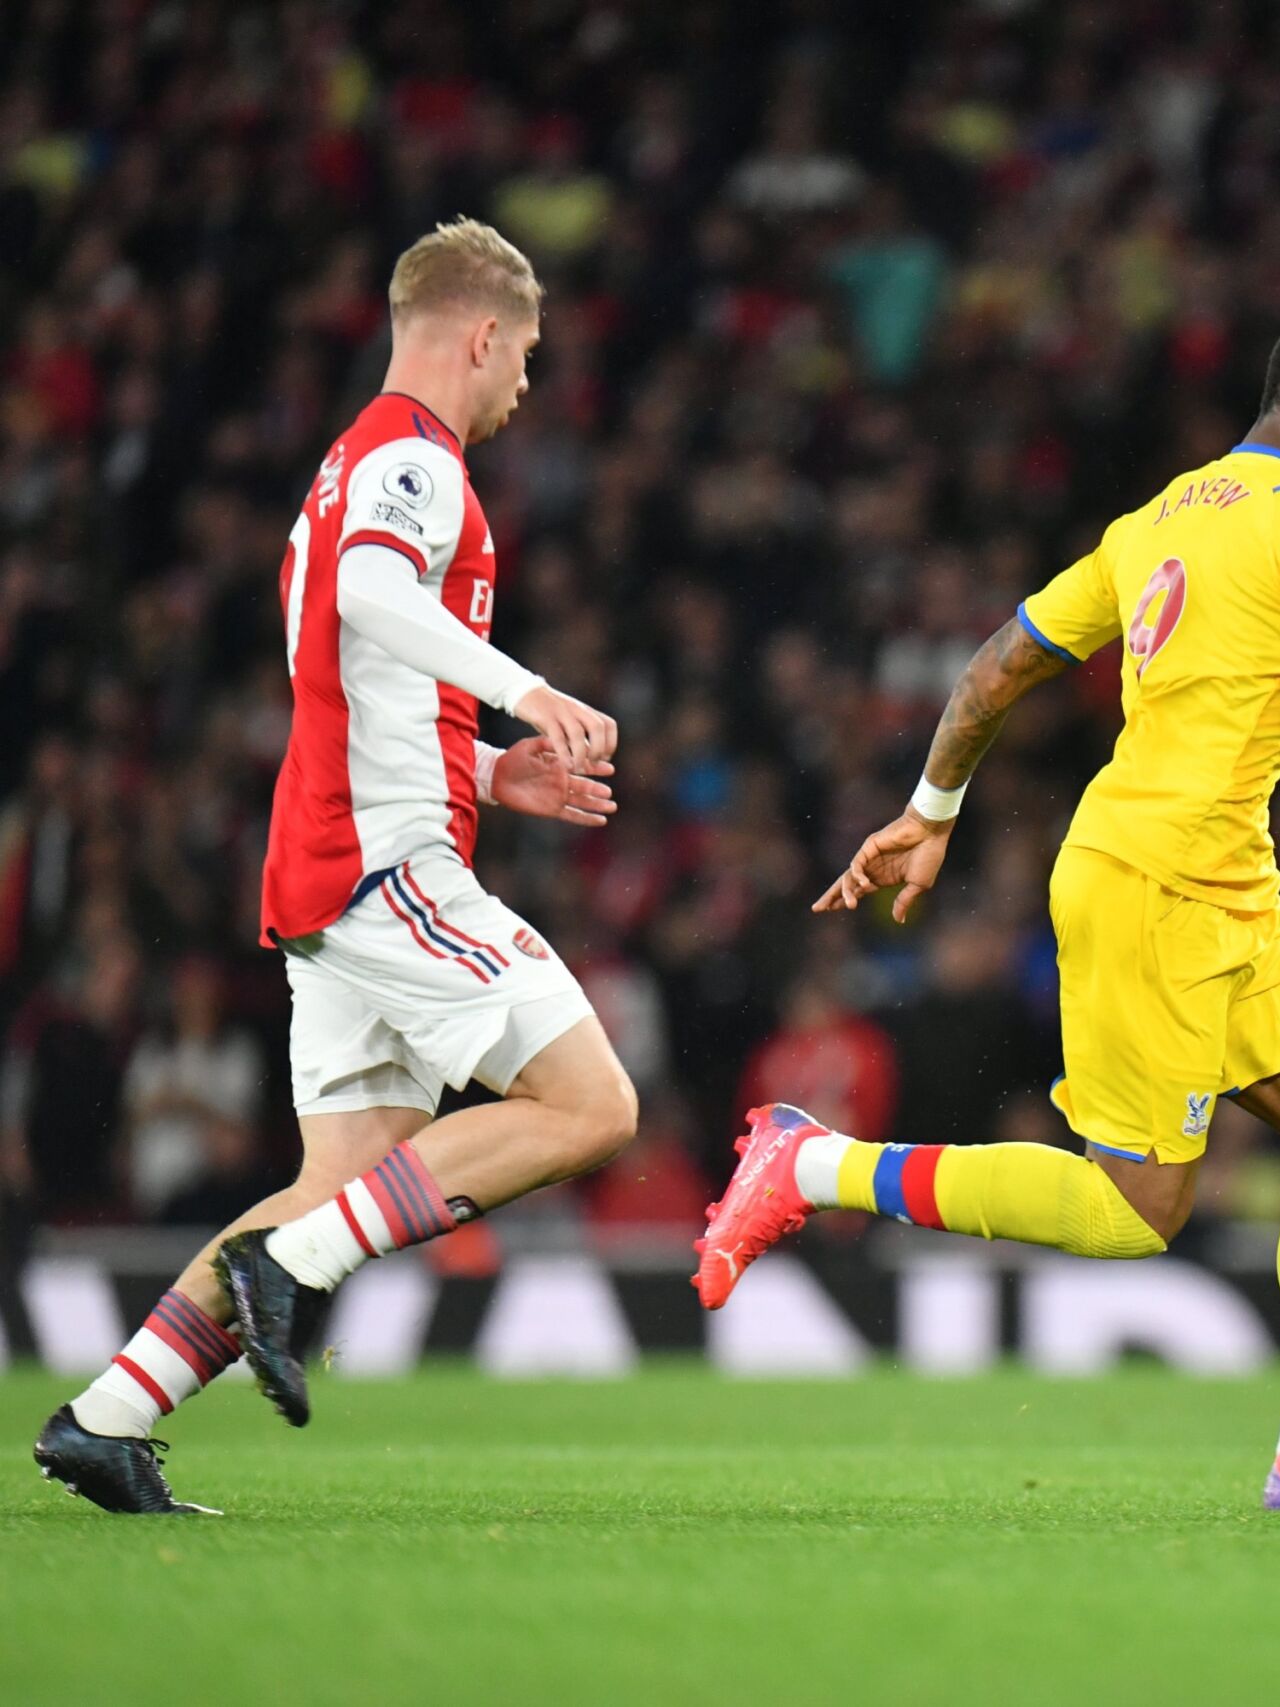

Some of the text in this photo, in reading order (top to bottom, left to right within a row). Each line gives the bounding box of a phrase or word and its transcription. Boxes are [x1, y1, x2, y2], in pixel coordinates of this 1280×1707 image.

[1153, 477, 1251, 526] J. AYEW
[1128, 557, 1186, 686] 9
[739, 1129, 796, 1186] ULTRA
